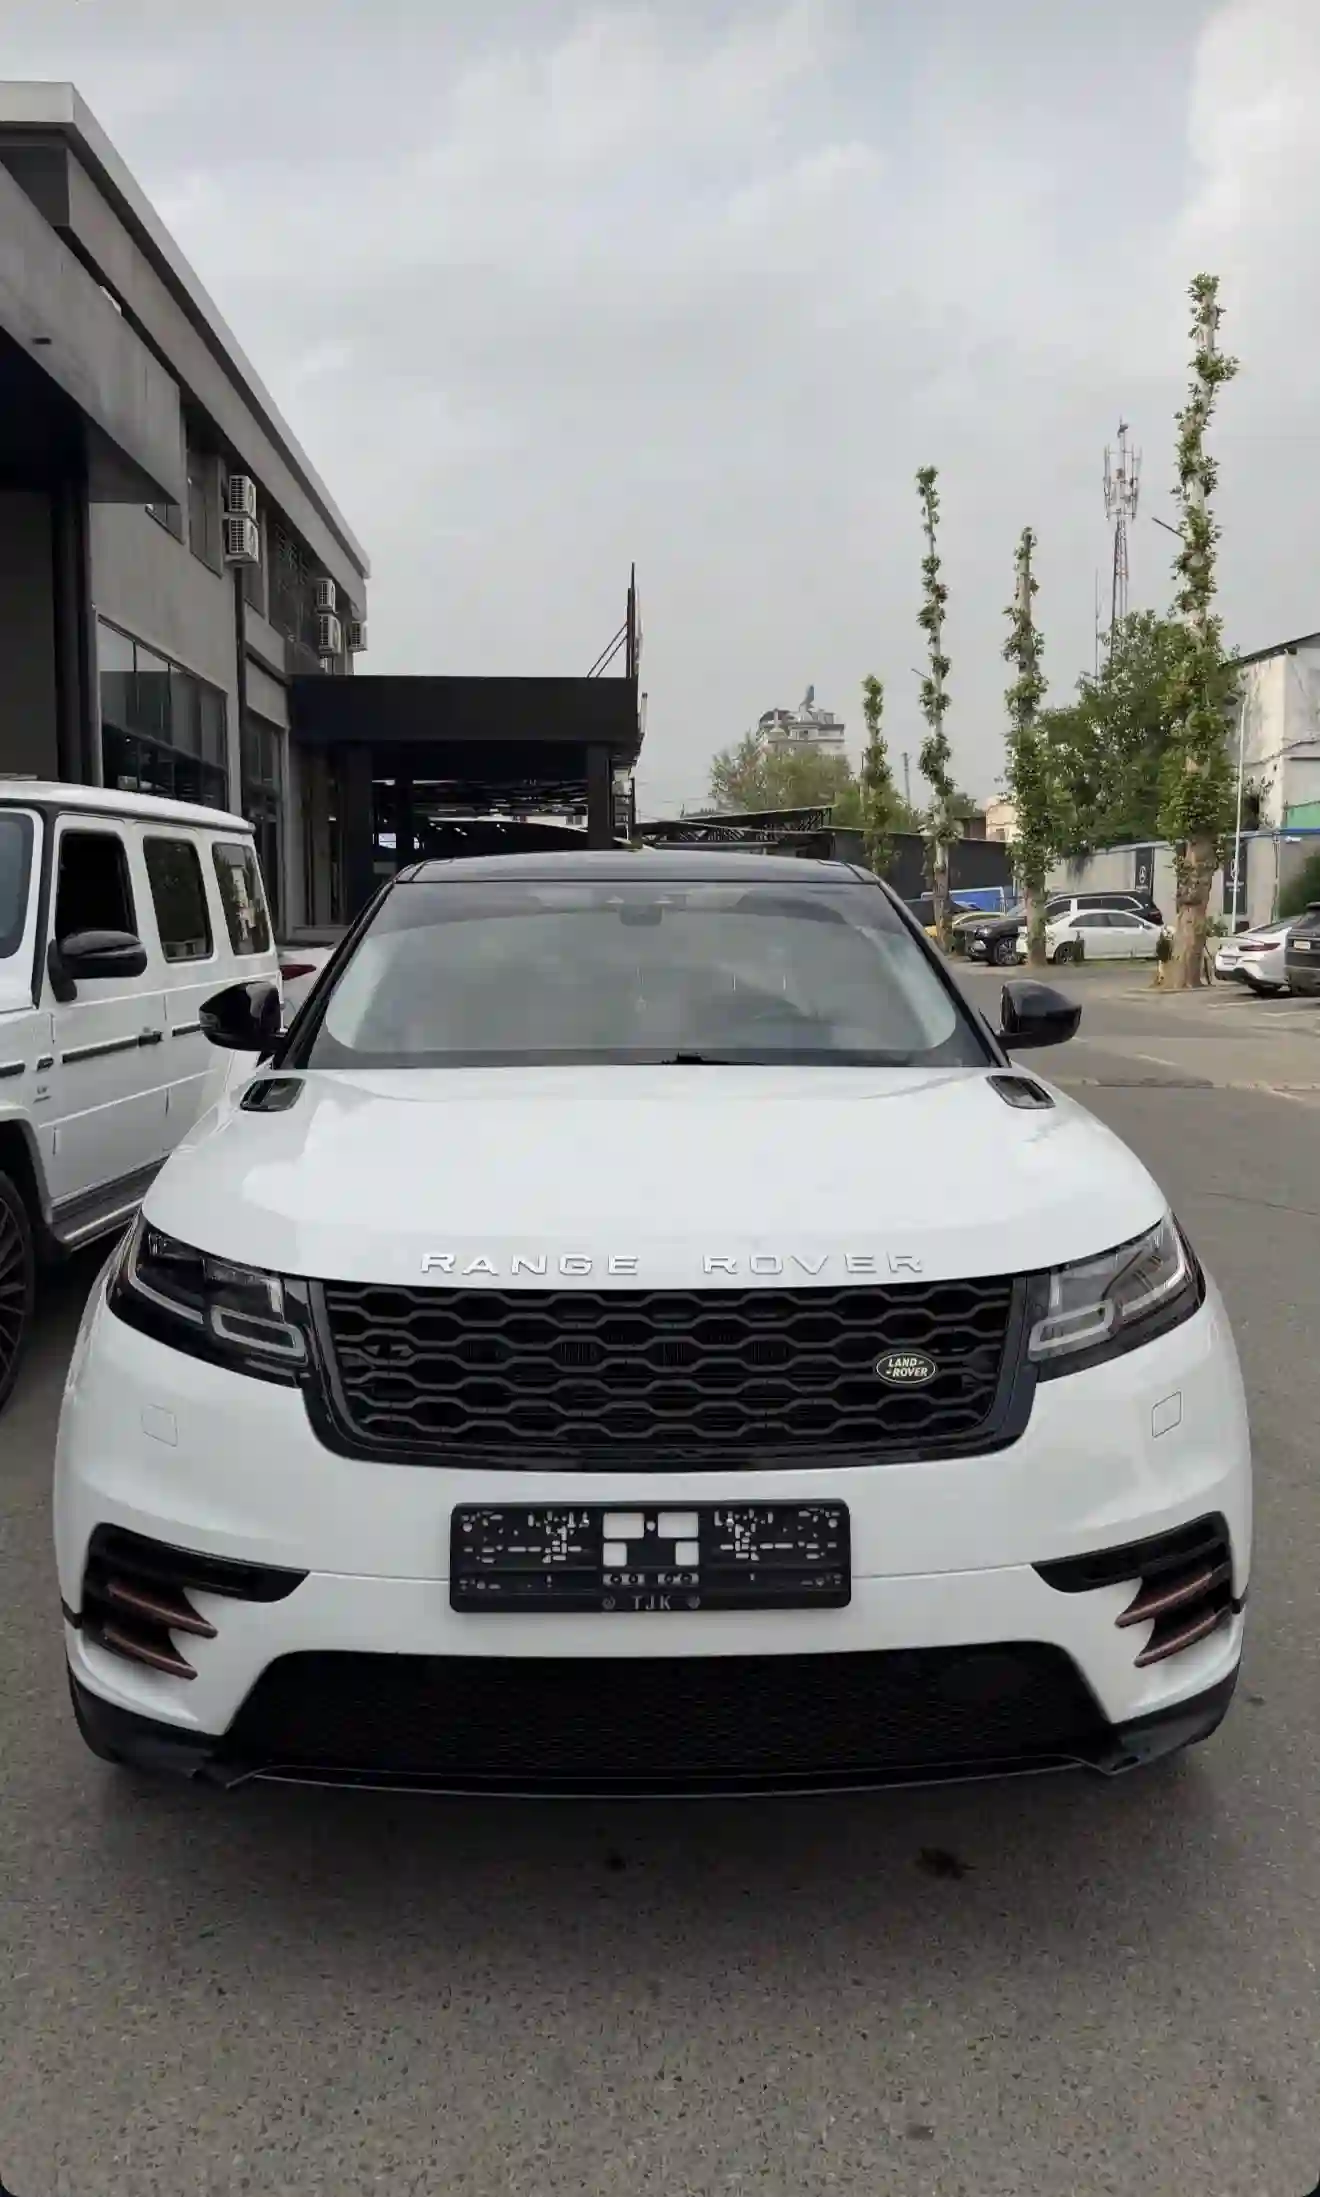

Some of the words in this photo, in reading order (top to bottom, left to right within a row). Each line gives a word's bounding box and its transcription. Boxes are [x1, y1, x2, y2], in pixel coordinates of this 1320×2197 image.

[420, 1253, 640, 1276] RANGE
[702, 1252, 923, 1275] ROVER
[888, 1357, 918, 1368] LAND
[892, 1367, 929, 1377] ROVER
